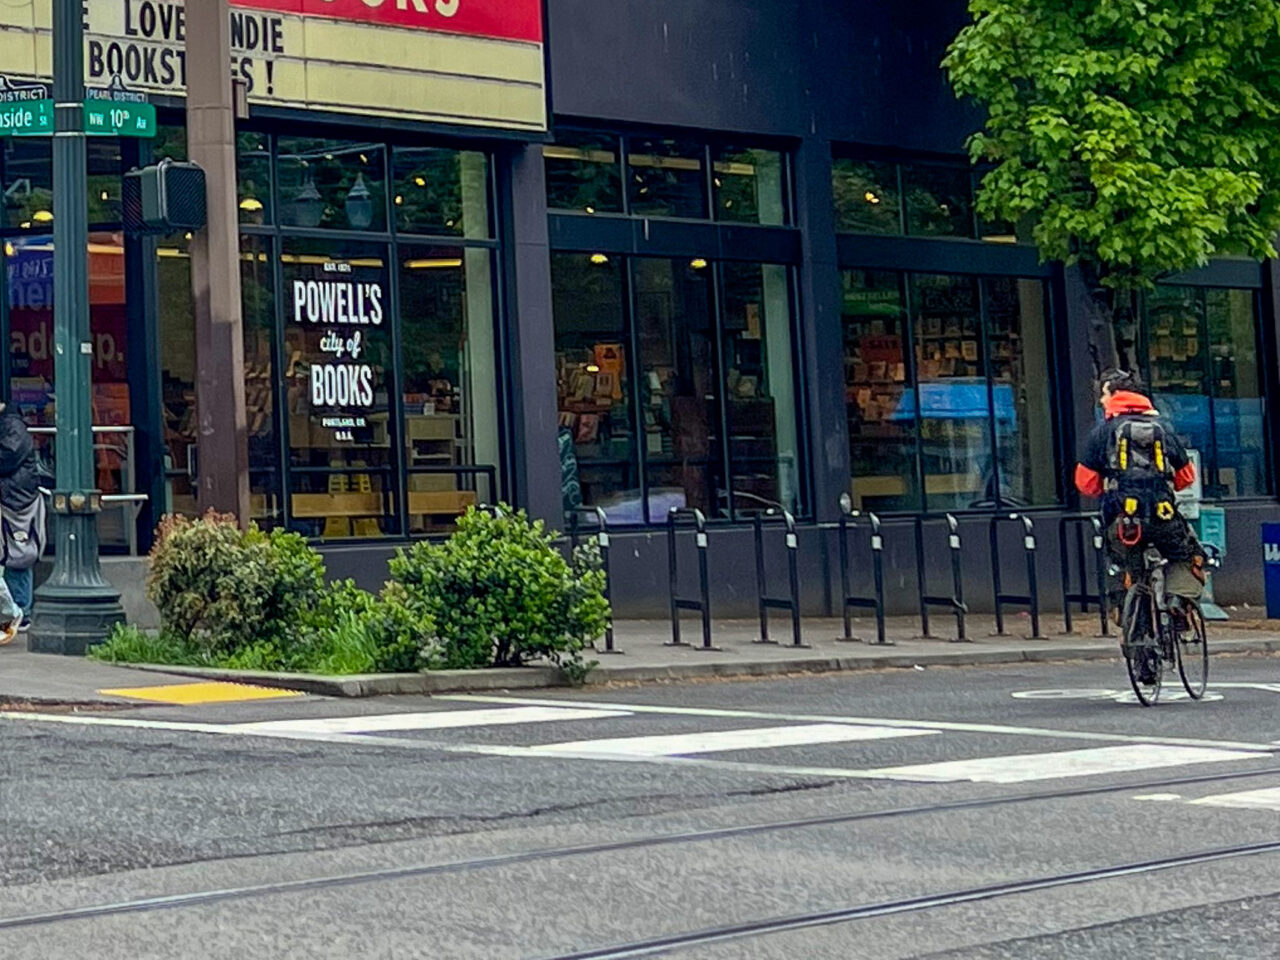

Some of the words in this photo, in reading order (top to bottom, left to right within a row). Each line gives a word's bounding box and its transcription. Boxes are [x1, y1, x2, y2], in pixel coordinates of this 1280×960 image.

[124, 0, 186, 42] LOVE
[230, 12, 284, 53] NDIE
[89, 88, 111, 100] PEARL
[114, 91, 145, 103] DISTRICT
[89, 113, 104, 125] NW
[293, 280, 383, 325] POWELL'S
[320, 330, 345, 358] city
[346, 330, 361, 359] of
[311, 364, 373, 406] BOOKS
